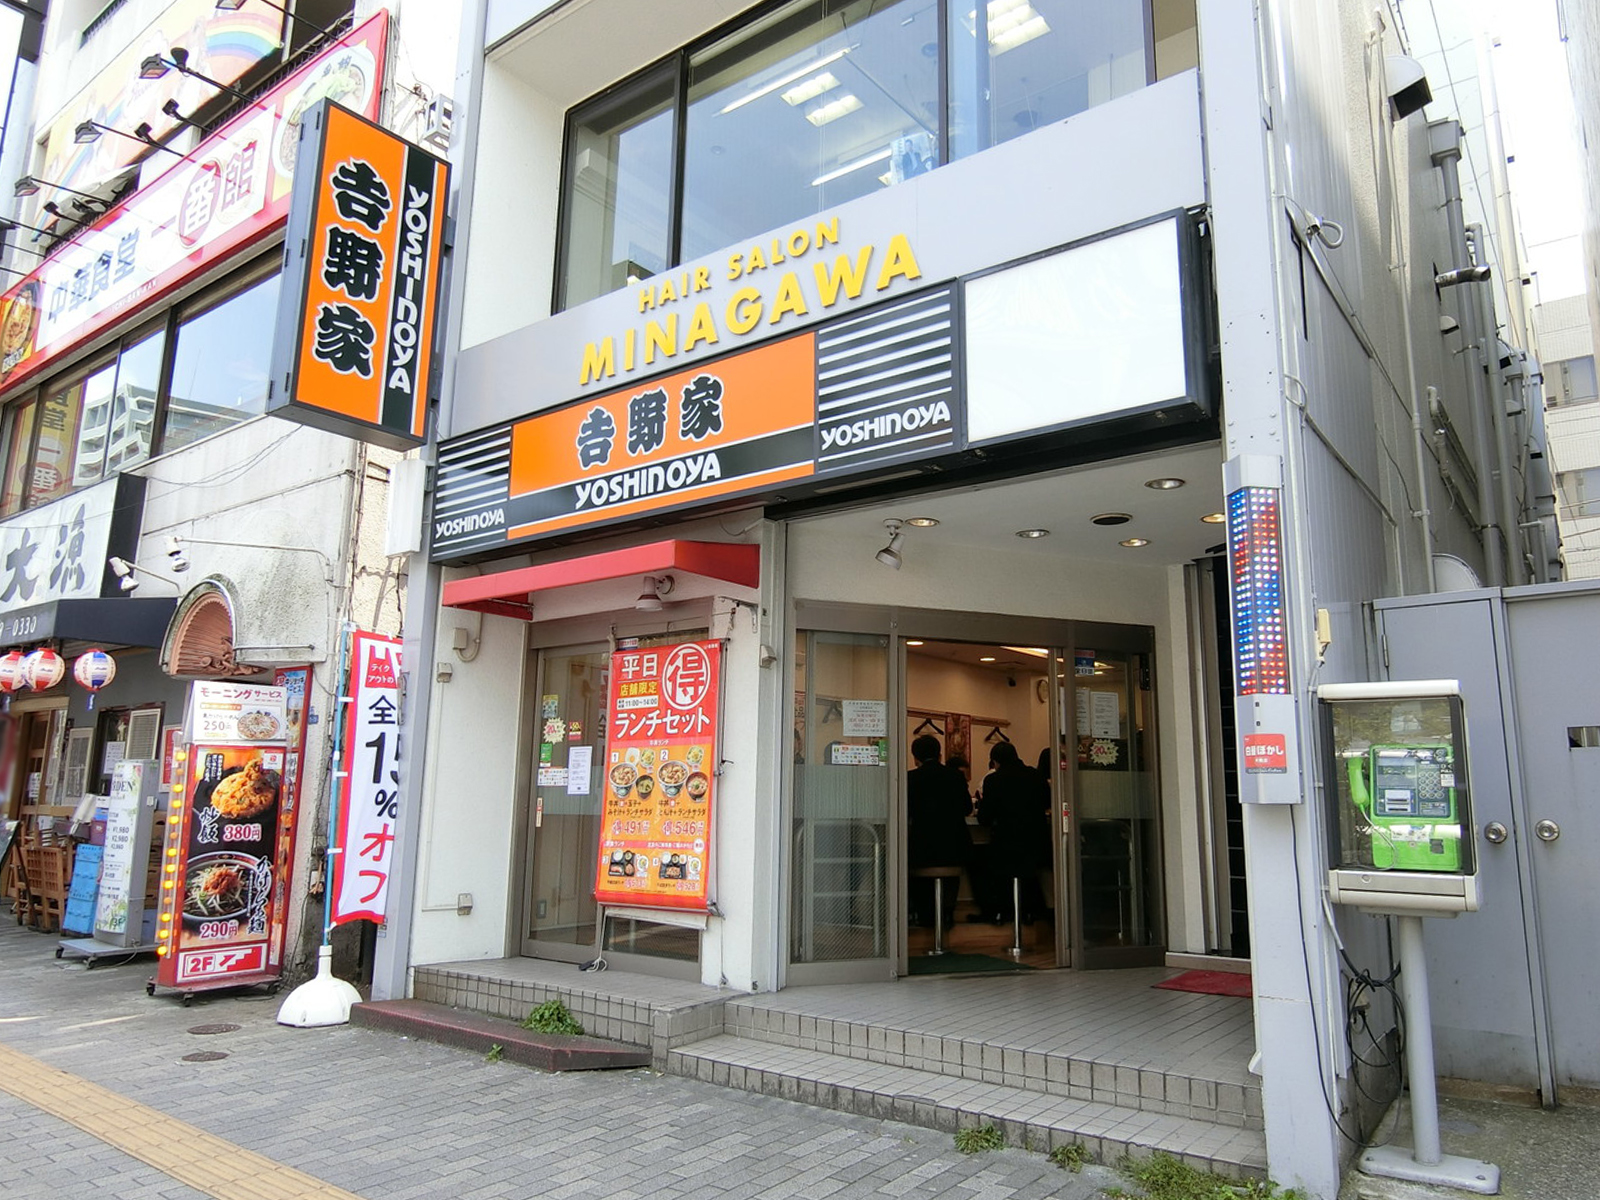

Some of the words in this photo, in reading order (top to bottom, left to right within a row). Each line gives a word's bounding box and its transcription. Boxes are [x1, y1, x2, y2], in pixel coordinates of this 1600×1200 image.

[389, 184, 430, 395] YOSHINOYA
[639, 266, 712, 313] HAIR
[726, 216, 841, 281] SALON
[579, 233, 923, 386] MINAGAWA
[576, 373, 724, 470] 吉野家
[819, 400, 952, 451] YOSHINOYA
[575, 452, 722, 511] YOSHINOYA
[435, 507, 506, 539] YOSHINOYA
[620, 681, 658, 697] 店舗限定
[621, 653, 658, 679] 平日
[666, 648, 708, 705] 得
[615, 707, 711, 739] ランチセット
[189, 957, 213, 972] 2F
